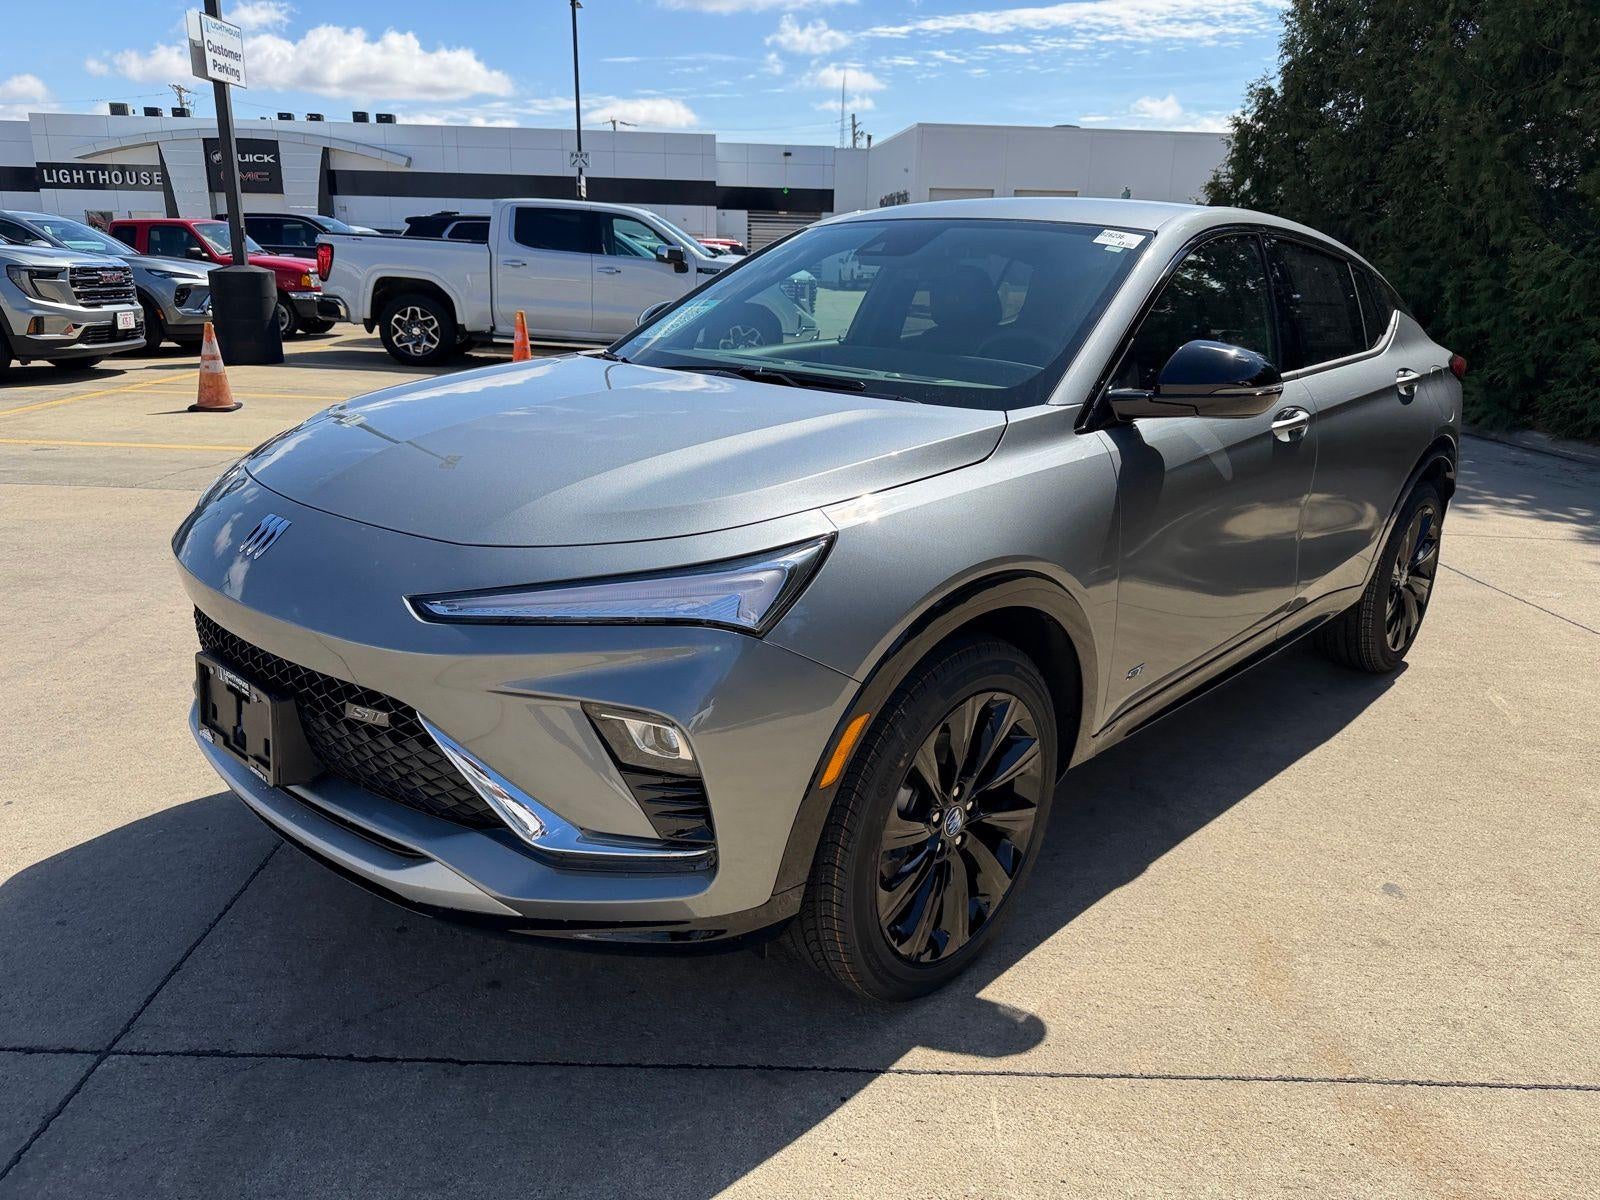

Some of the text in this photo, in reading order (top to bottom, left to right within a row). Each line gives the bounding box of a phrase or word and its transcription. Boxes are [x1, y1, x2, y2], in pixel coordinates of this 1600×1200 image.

[206, 39, 242, 62] Customer
[212, 59, 241, 82] Parking
[237, 153, 277, 163] UICK
[42, 168, 164, 186] LIGHTHOUSE
[350, 705, 388, 726] ST
